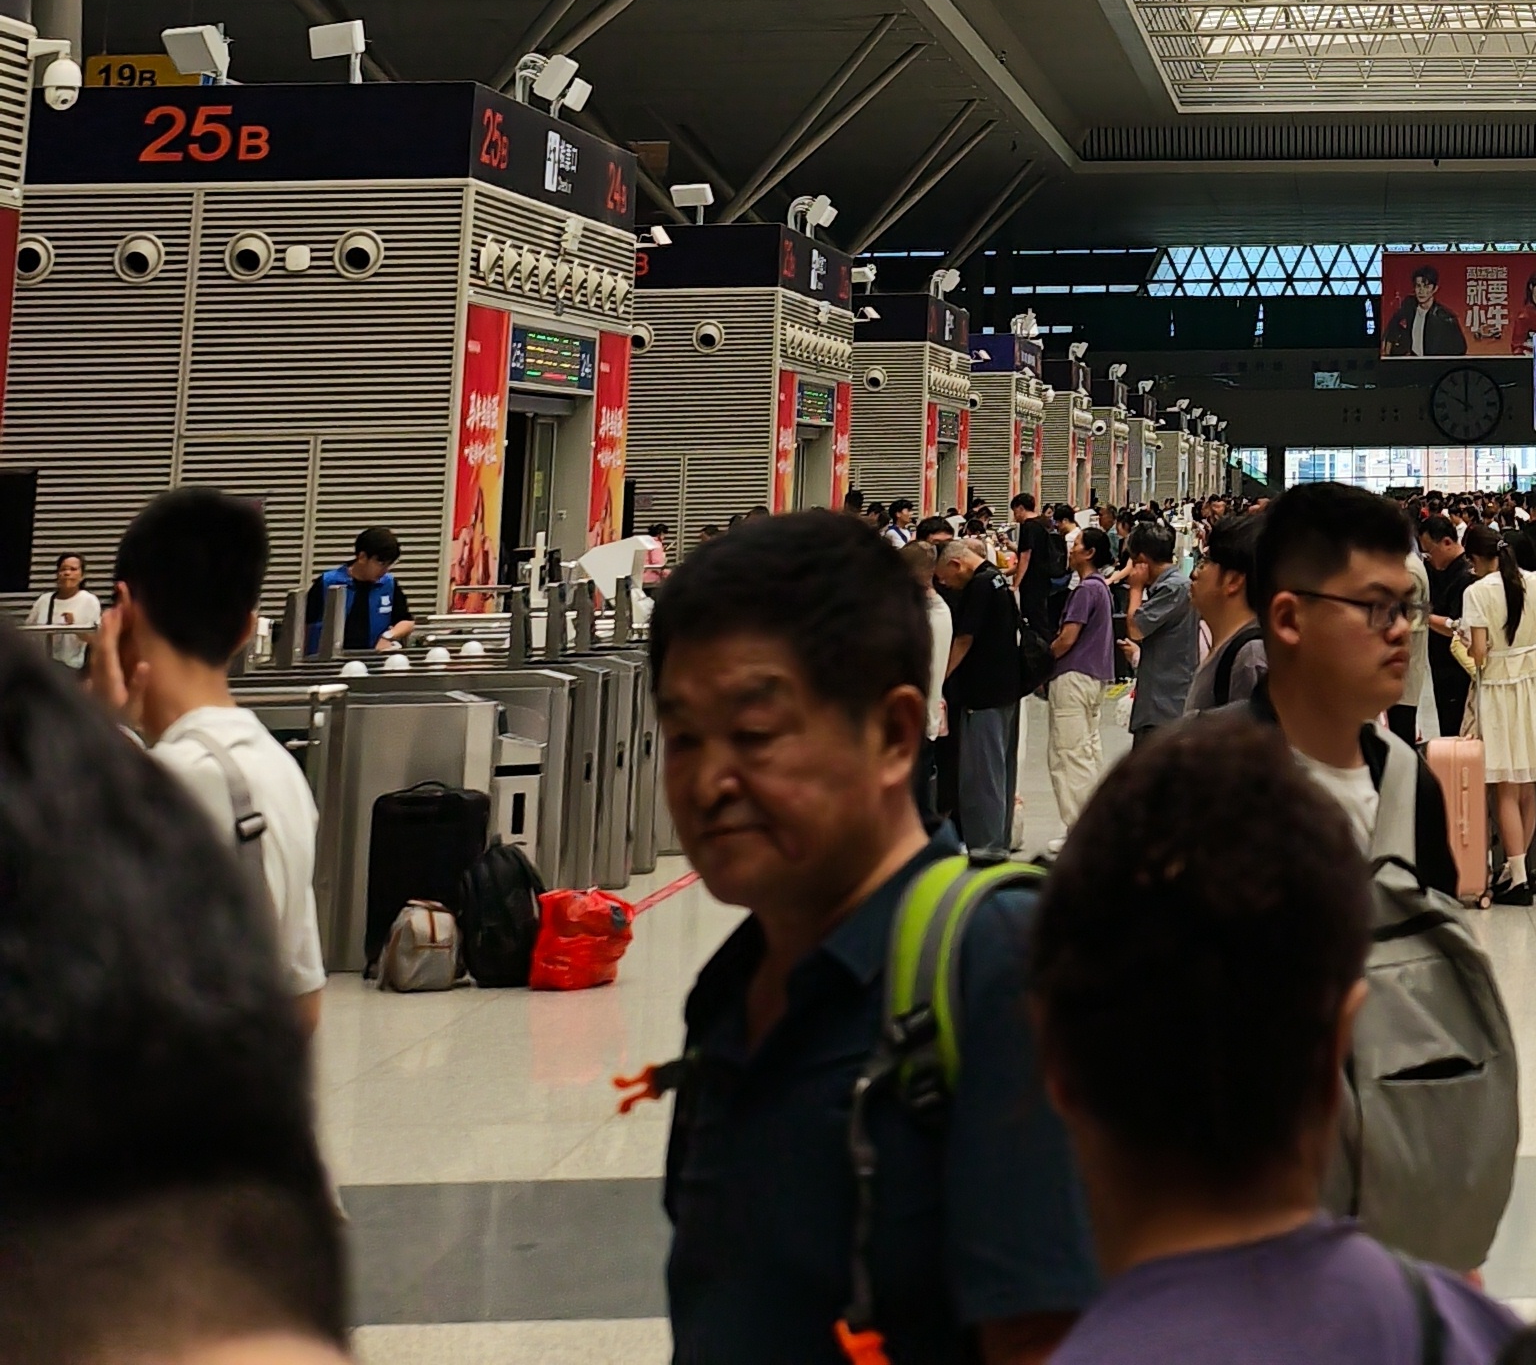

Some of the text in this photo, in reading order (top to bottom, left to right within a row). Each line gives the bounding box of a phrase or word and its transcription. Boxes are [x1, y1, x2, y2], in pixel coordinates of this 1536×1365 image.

[97, 63, 157, 87] 19B
[139, 105, 271, 162] 25B
[480, 107, 510, 170] 25B
[1466, 280, 1509, 305] 就要
[1465, 305, 1509, 333] 小牛
